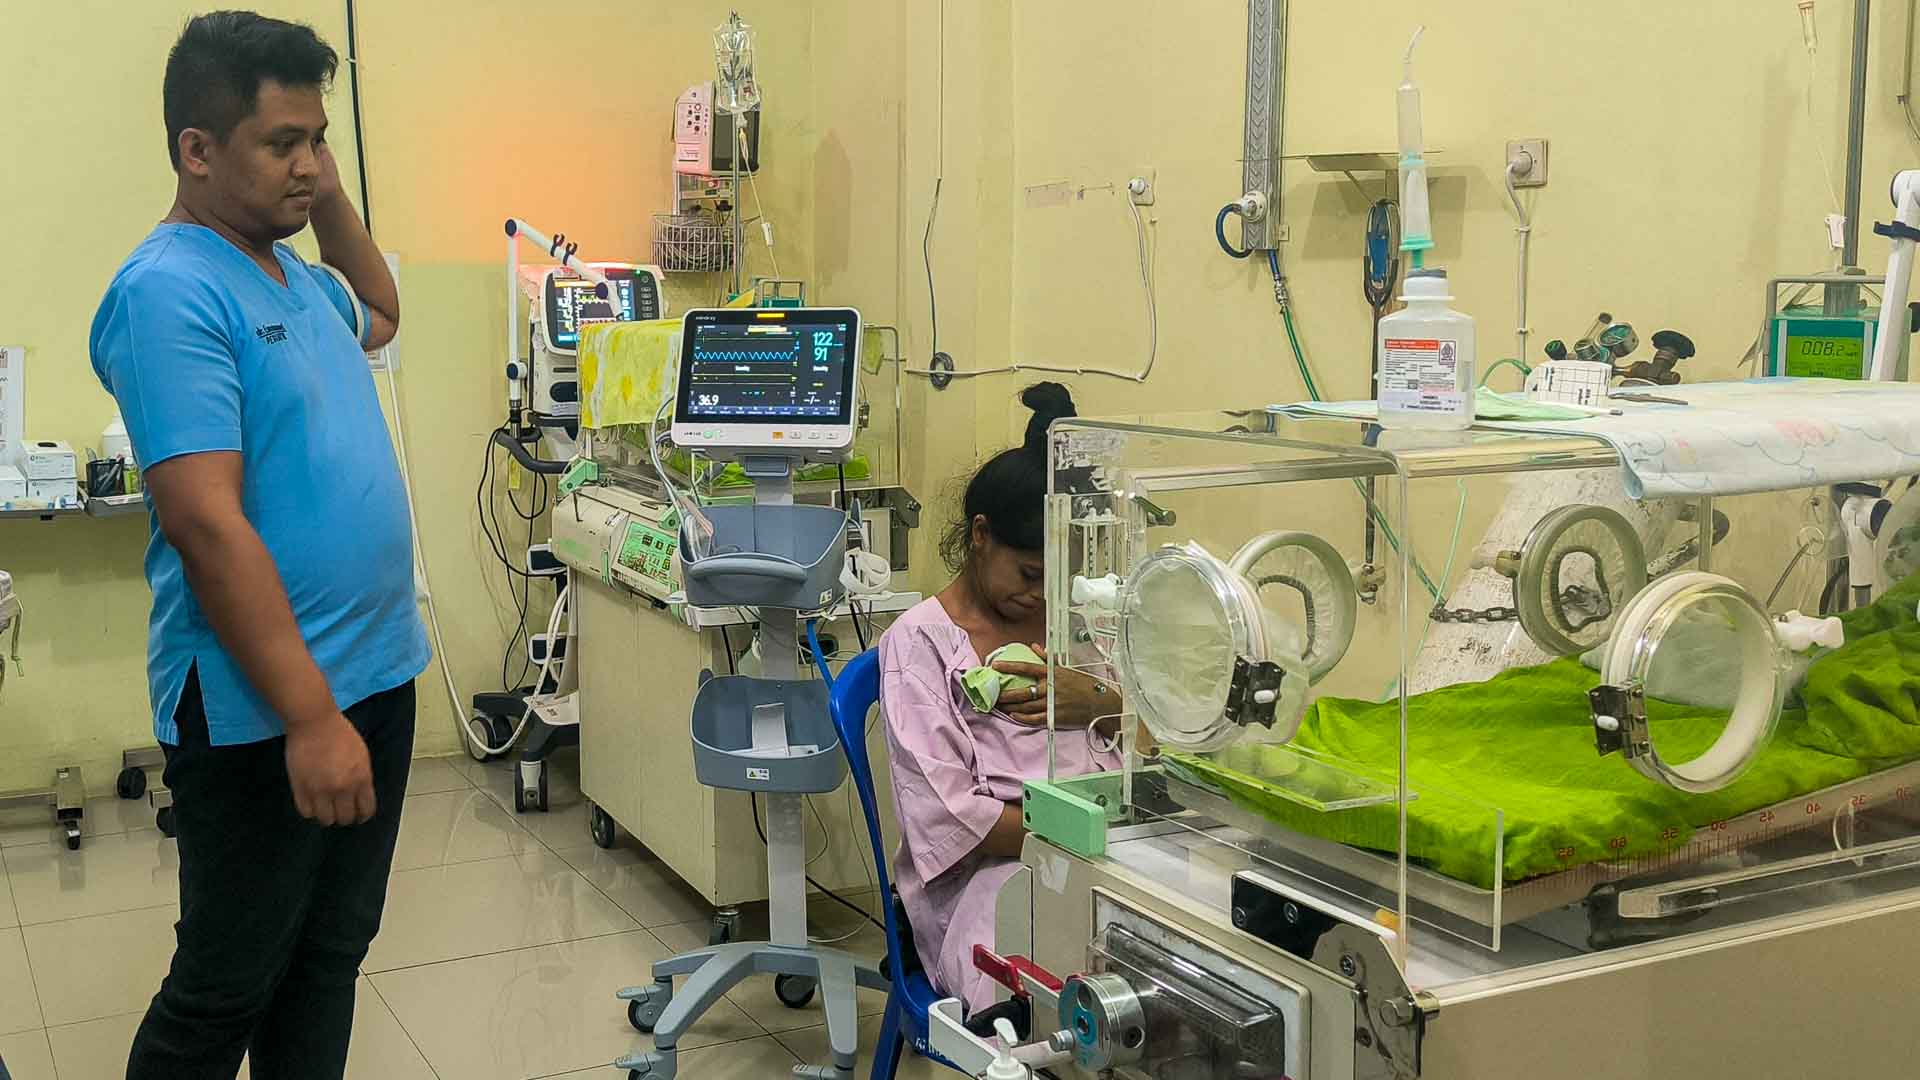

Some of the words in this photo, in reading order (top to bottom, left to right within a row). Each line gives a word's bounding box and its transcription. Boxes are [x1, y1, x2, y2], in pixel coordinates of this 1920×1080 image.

[813, 332, 833, 346] 122
[815, 347, 828, 361] 91
[698, 395, 720, 406] 36.9
